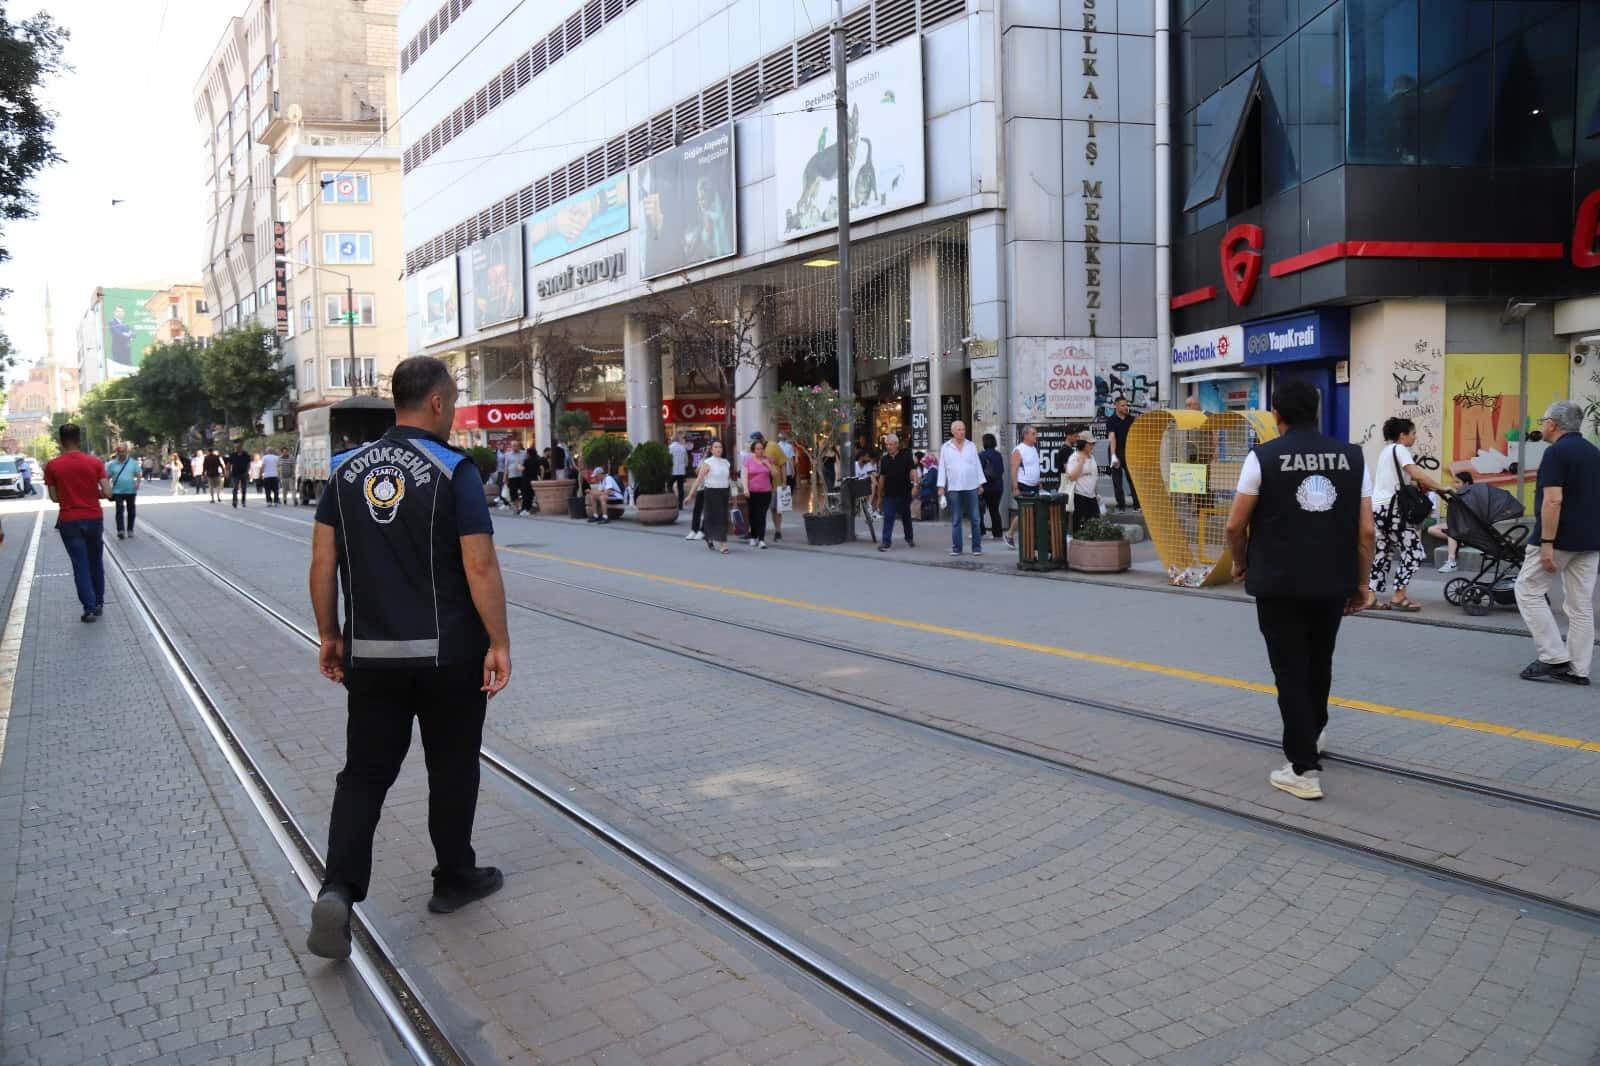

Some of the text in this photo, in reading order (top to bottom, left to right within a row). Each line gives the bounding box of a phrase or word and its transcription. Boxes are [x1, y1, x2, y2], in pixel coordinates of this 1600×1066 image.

[1085, 114, 1098, 166] İŞ
[1081, 180, 1103, 337] MERKEZİ
[537, 248, 627, 298] esnaf sarayı
[1268, 325, 1314, 353] YapıKredi
[1173, 342, 1216, 364] DenizBank
[1053, 364, 1088, 377] GALA
[1048, 379, 1093, 391] GRAND
[504, 409, 535, 421] vodaf
[1279, 453, 1351, 472] ZABITA
